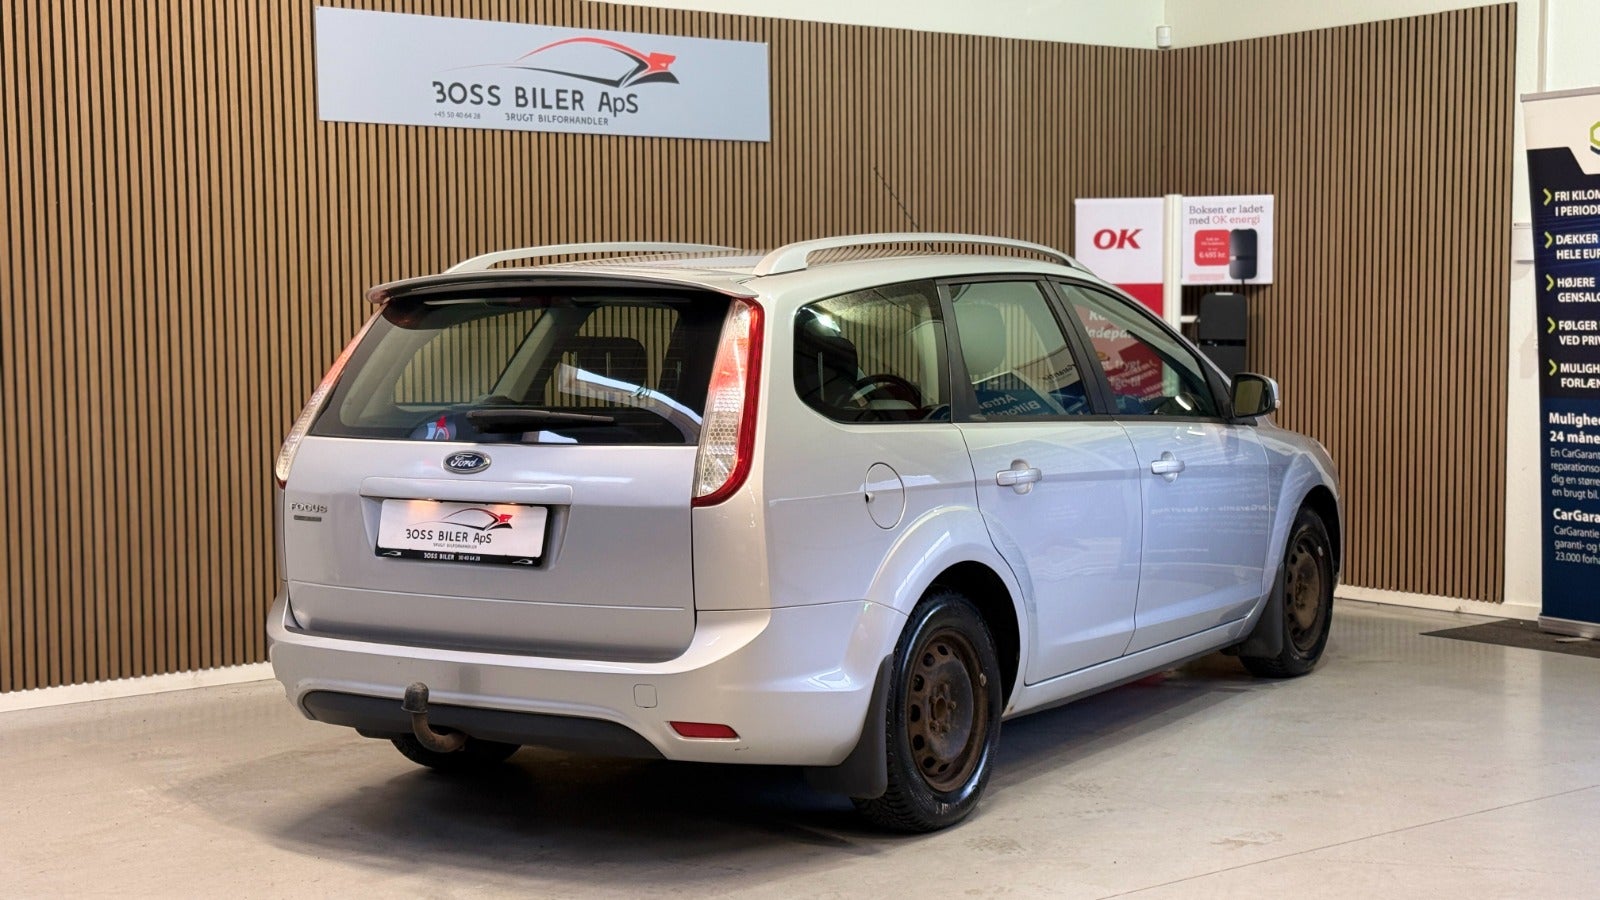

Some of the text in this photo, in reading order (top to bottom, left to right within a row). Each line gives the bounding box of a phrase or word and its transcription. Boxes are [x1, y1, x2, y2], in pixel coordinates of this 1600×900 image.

[514, 86, 584, 112] BILER
[598, 92, 638, 117] ApS
[538, 114, 609, 126] BILFORHANDLER
[1554, 191, 1570, 202] FRI
[1189, 205, 1224, 214] Boksen
[1239, 205, 1264, 213] ladet
[1555, 207, 1559, 217] I
[1189, 215, 1260, 226] med OK energi
[1093, 228, 1143, 250] OK
[1556, 234, 1599, 245] DÆKKER
[1556, 249, 1582, 260] HELE
[1557, 277, 1596, 288] HØJERE
[1558, 320, 1598, 331] FØLGER
[1559, 335, 1580, 346] VED
[1560, 362, 1600, 374] MULIGH
[1549, 412, 1600, 428] Mulighe
[1550, 430, 1600, 444] 24 måne
[1550, 448, 1560, 457] En
[450, 454, 477, 468] Ford
[1551, 462, 1600, 473] reparationso
[1551, 474, 1565, 486] dig
[1552, 488, 1562, 496] en
[1563, 487, 1586, 500] brugt
[289, 502, 328, 513] FOCUS
[438, 531, 468, 543] BILER
[473, 533, 492, 545] ApS
[1553, 525, 1600, 539] CarGarantie
[1554, 540, 1597, 553] garanti- og
[1555, 551, 1580, 563] 23.000
